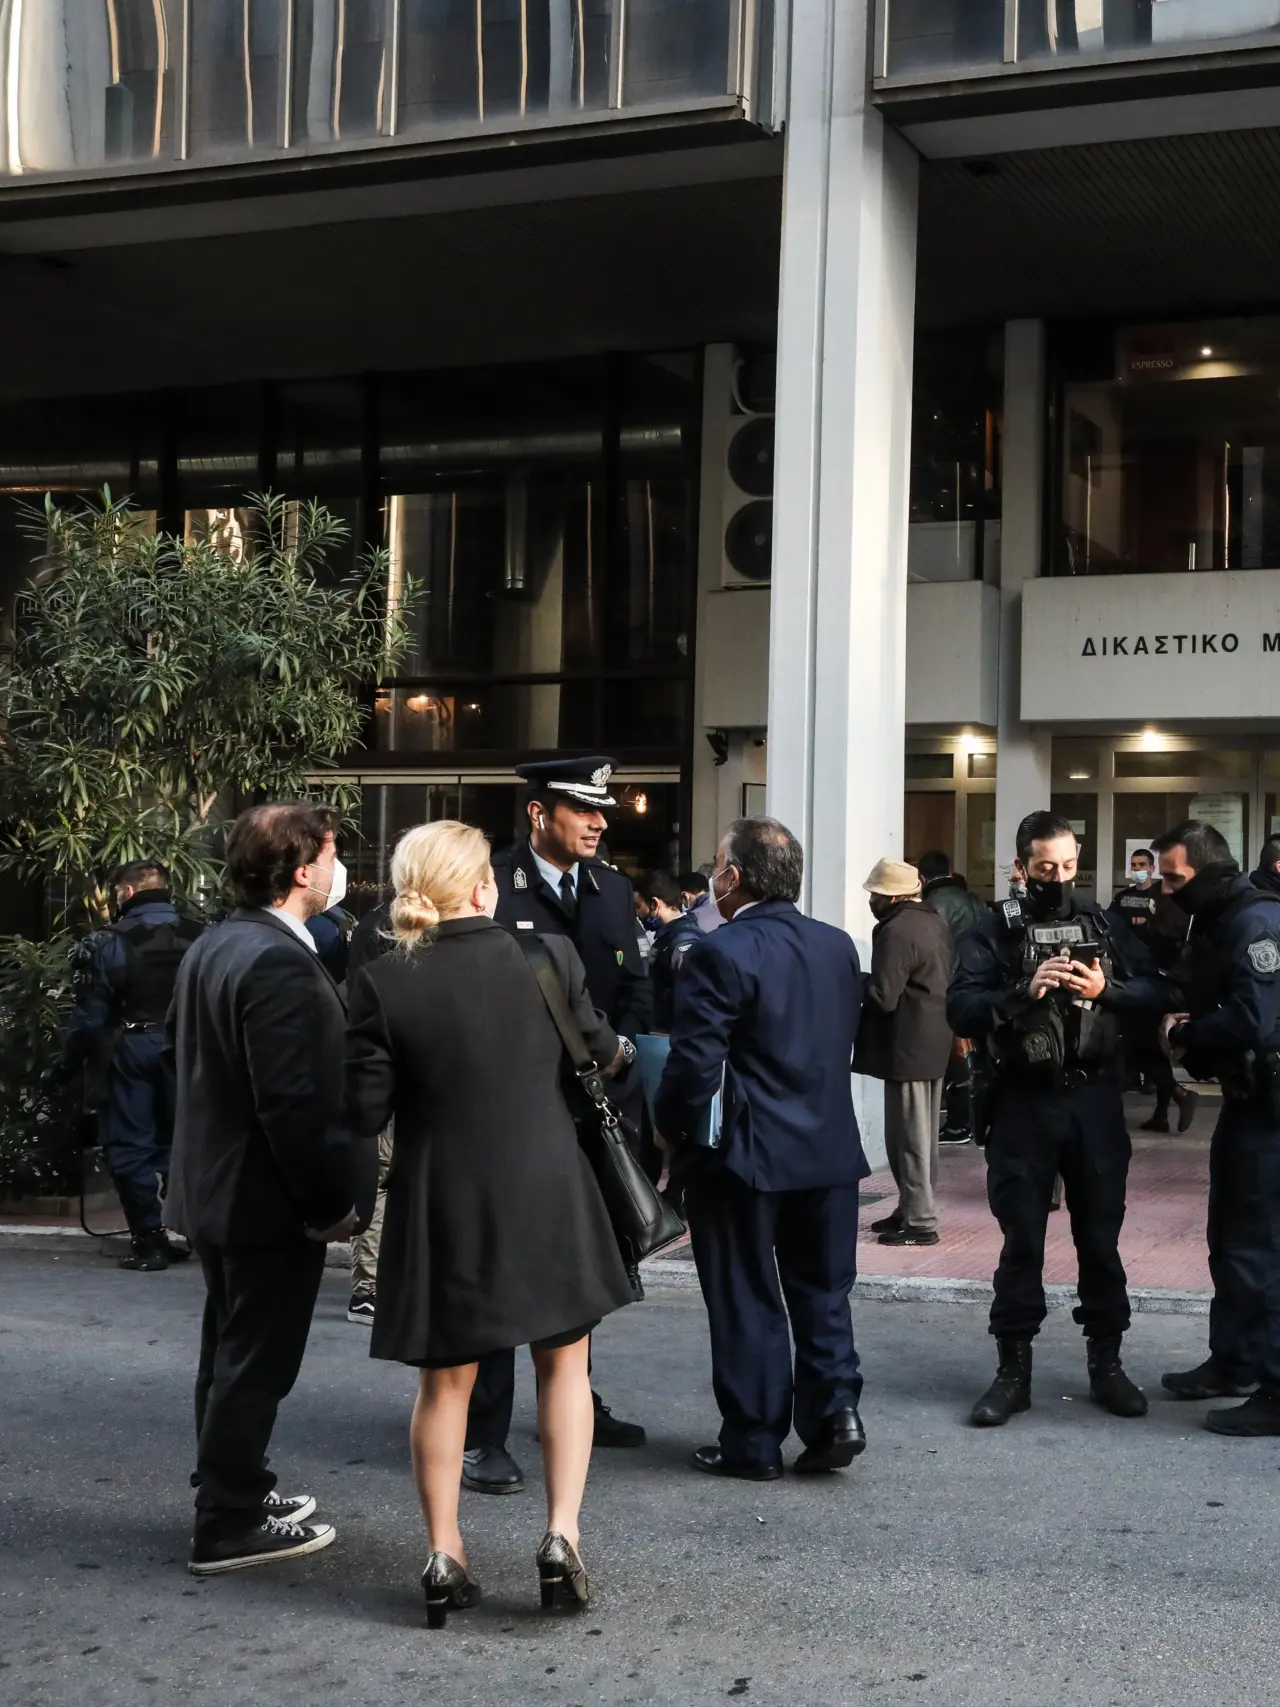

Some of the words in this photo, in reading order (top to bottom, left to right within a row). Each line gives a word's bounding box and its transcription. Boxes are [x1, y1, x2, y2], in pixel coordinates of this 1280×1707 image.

[1131, 359, 1174, 370] ESPRESSO
[1081, 633, 1239, 657] ΔΙΚΑΣΤΙΚΟ
[1037, 928, 1081, 942] POLICE
